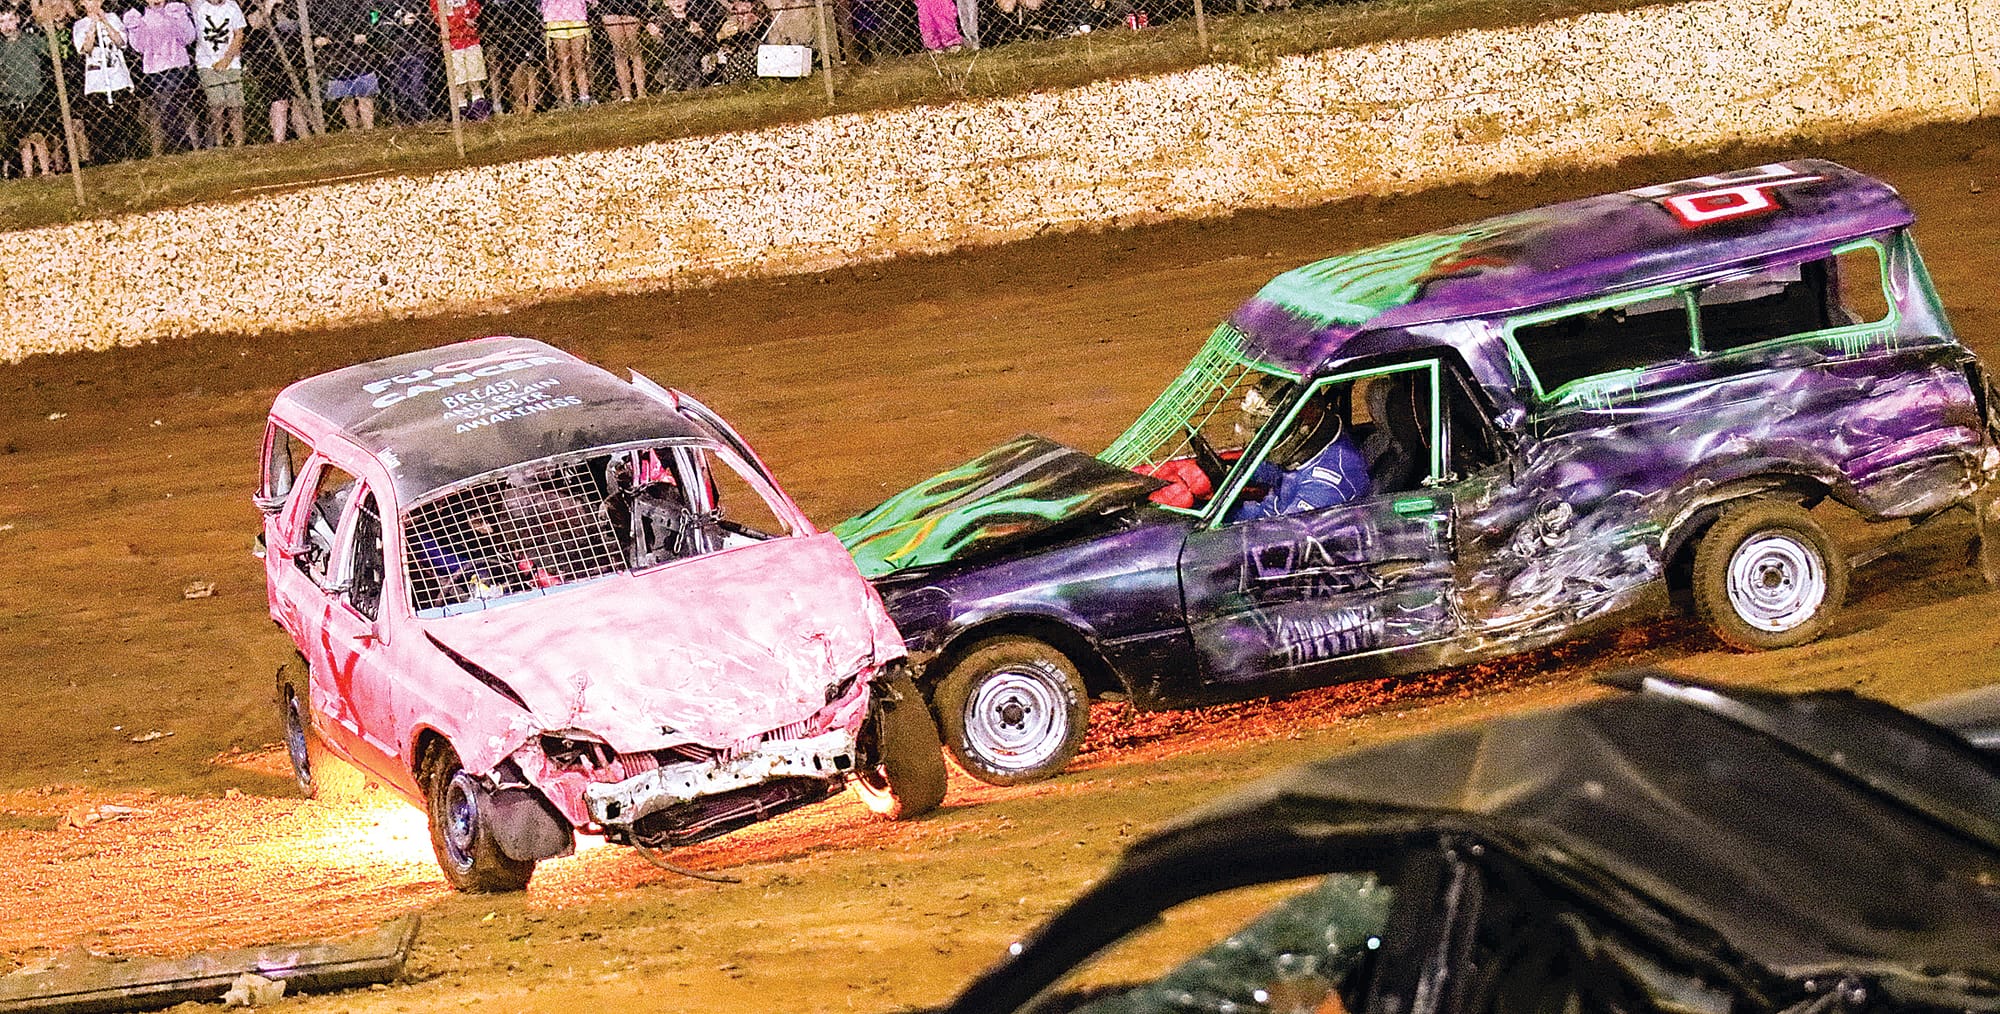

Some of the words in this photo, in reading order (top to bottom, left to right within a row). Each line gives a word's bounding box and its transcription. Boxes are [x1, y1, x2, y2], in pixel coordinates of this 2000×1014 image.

[371, 356, 565, 409] CANCER
[441, 378, 520, 409] BREAST
[443, 402, 486, 420] AND
[491, 378, 561, 403] BRAIN
[456, 395, 582, 434] AWARENESS
[464, 391, 552, 419] CANCER
